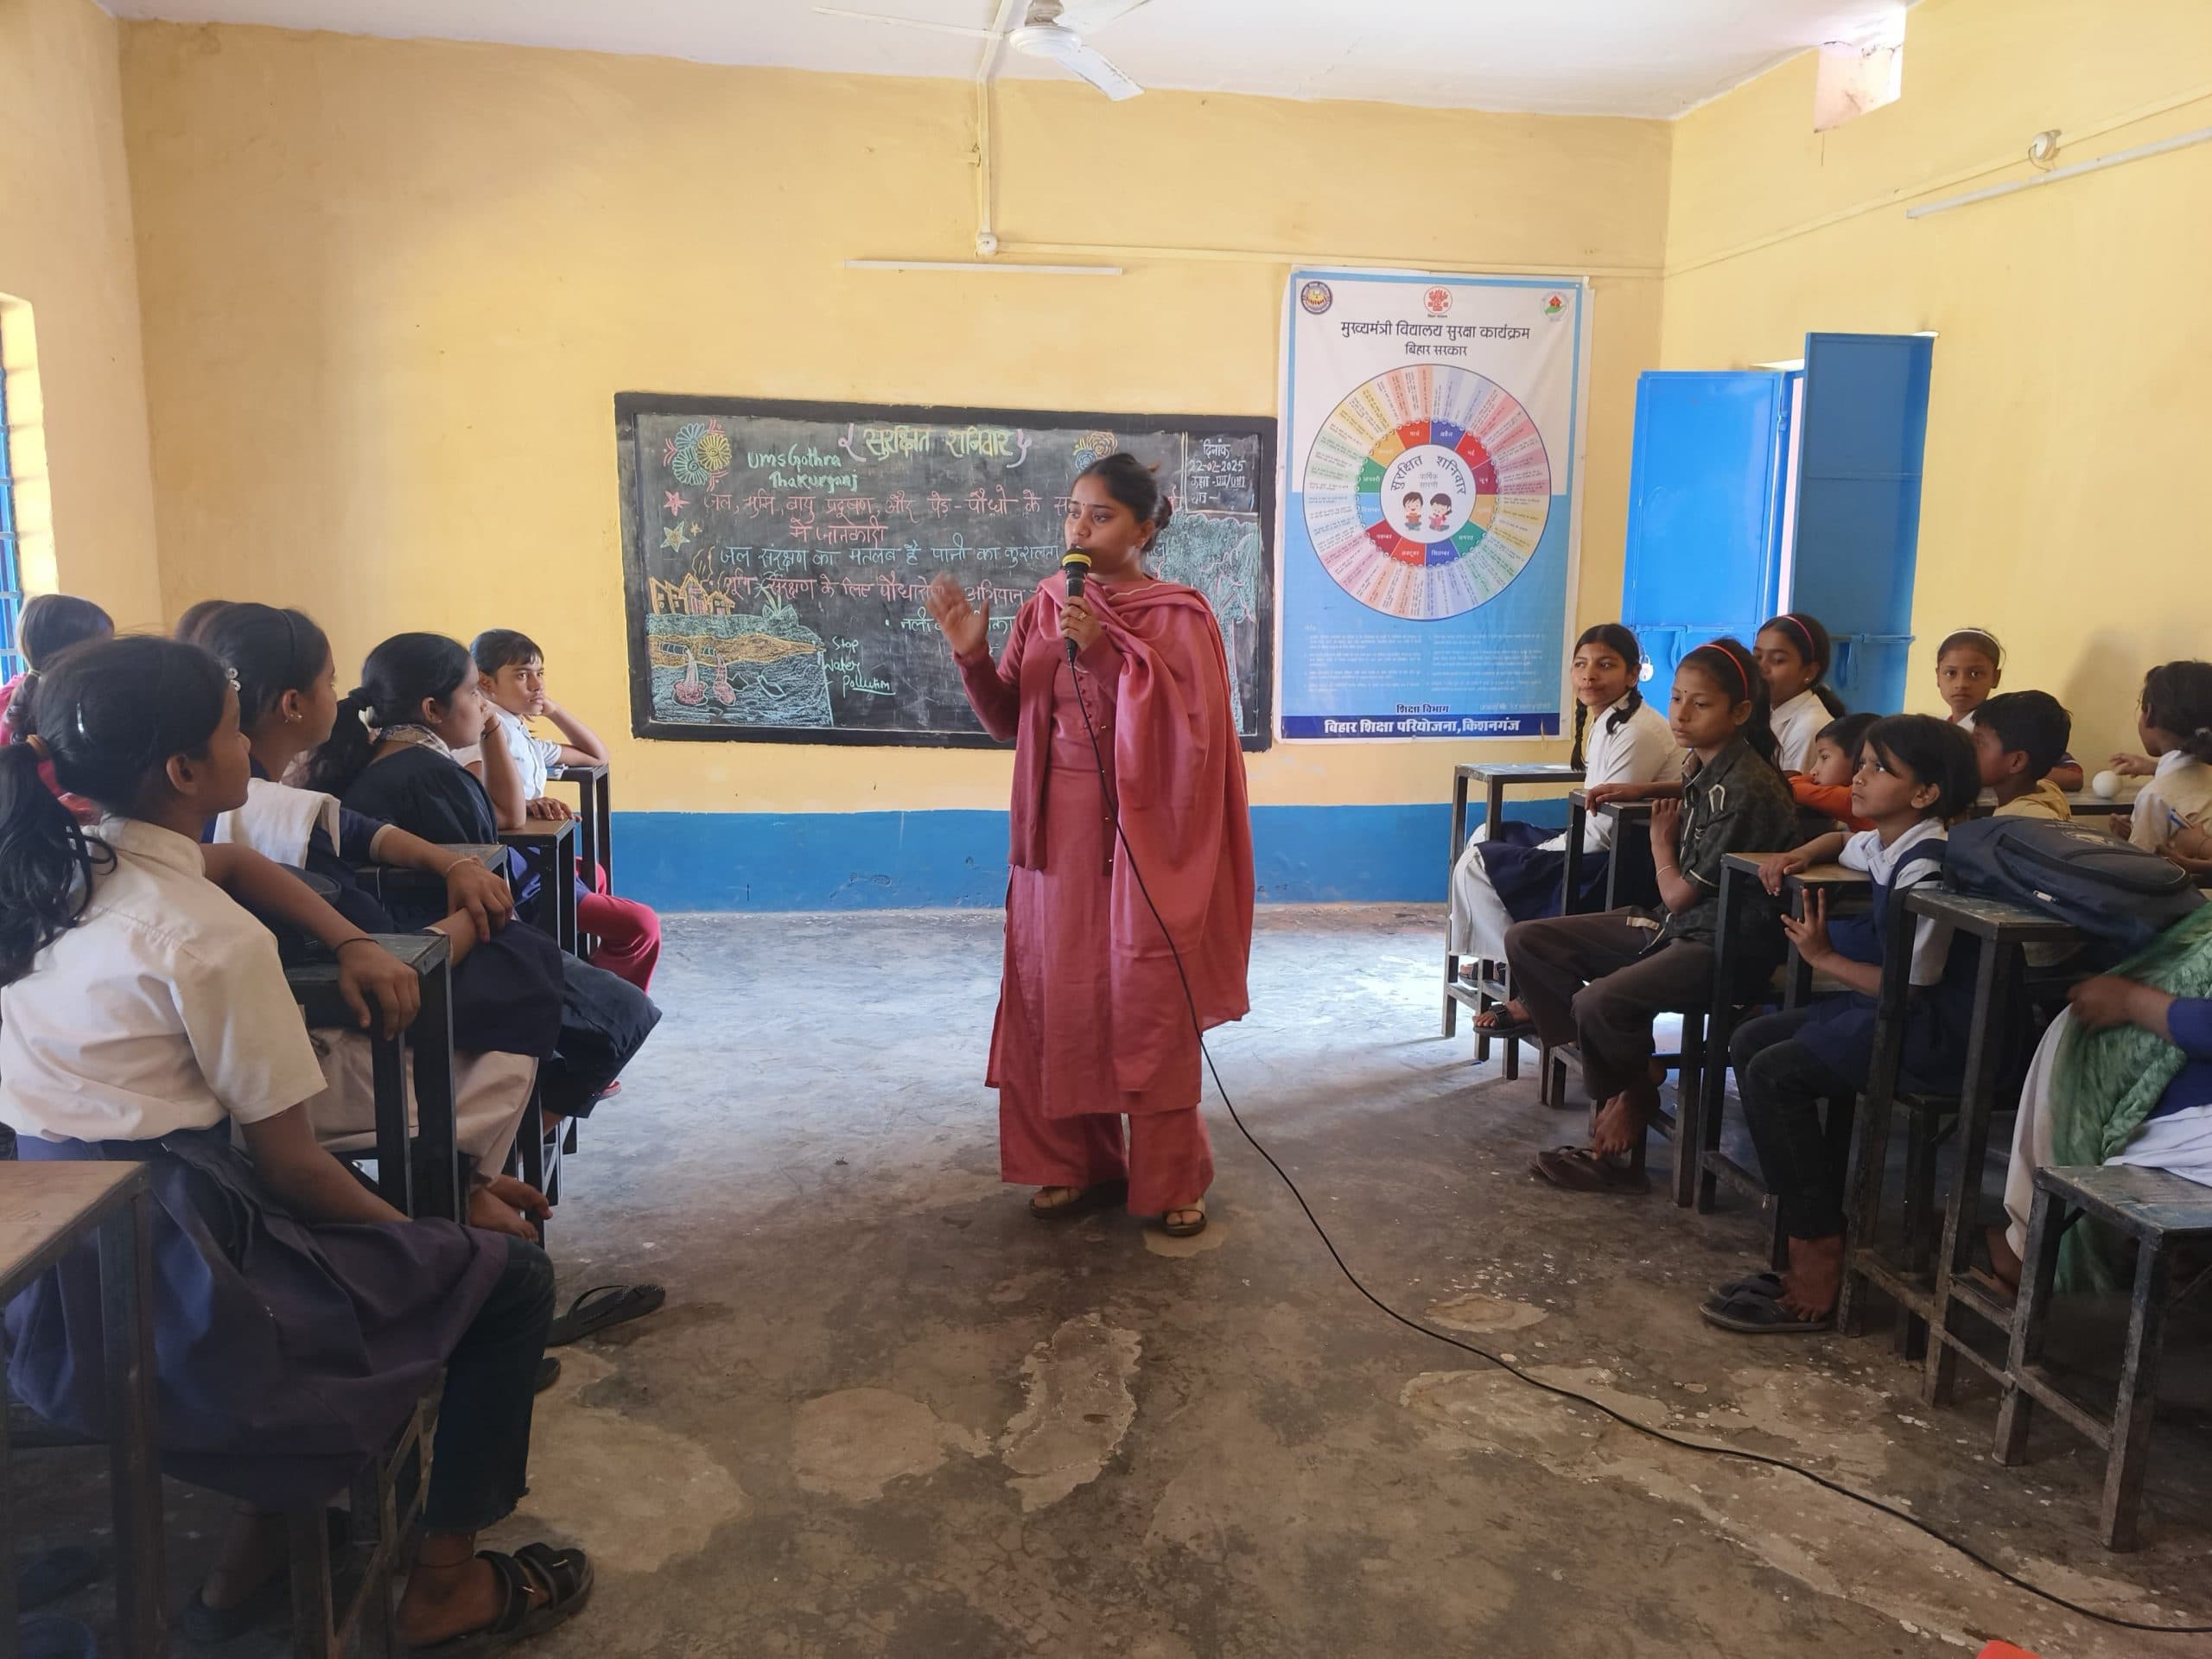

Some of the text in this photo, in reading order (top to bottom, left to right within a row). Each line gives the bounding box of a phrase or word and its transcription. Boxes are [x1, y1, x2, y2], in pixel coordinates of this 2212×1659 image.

[1340, 320, 1530, 340] मुख्यमंत्री विद्यालय सुरक्षा कार्यक्रम
[1405, 341, 1468, 357] बिहार सरकार
[864, 425, 1016, 461] सुरक्षित शनिवार
[1203, 438, 1230, 458] दिनांक
[1189, 460, 1247, 474] 22-02-2025
[1390, 454, 1423, 492] सुरक्षित
[1436, 454, 1467, 496] शनिवार
[885, 490, 919, 524] और
[816, 515, 889, 549] जानकारी
[720, 532, 1059, 572] जल संरक्षण का मतलब है पानी का कुशलता
[820, 573, 840, 597] के
[841, 576, 874, 597] लिए
[832, 636, 859, 653] Stop
[1396, 702, 1449, 714] शिक्षा विभाग
[1359, 718, 1393, 734] शिक्षा
